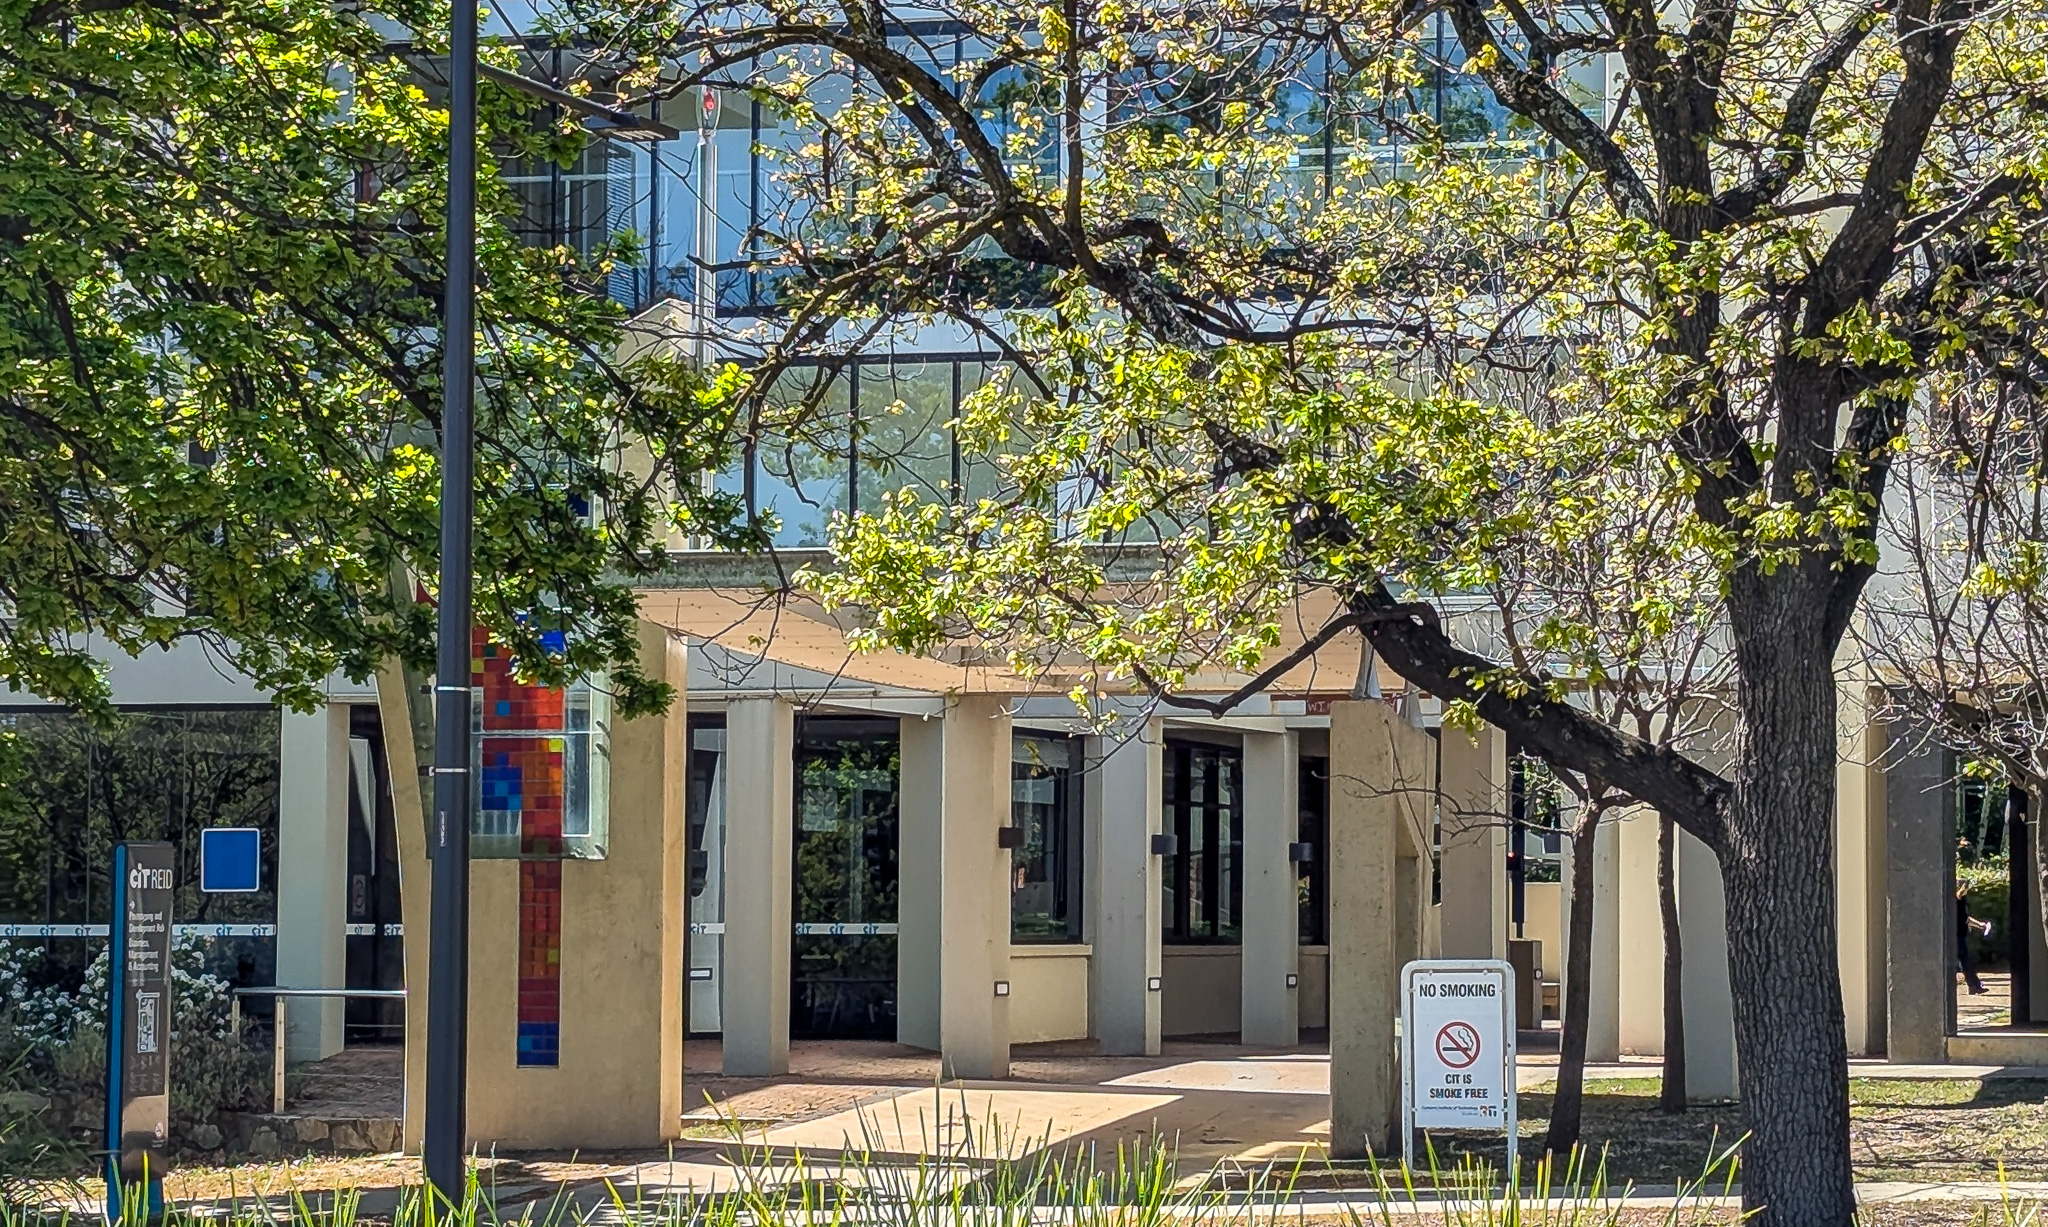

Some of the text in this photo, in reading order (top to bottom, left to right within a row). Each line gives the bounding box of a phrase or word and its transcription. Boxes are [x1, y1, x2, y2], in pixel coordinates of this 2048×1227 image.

[151, 868, 173, 889] REID
[1419, 984, 1496, 998] NO SMOKING
[1445, 1074, 1472, 1085] CIT IS
[1429, 1088, 1489, 1099] SMOKE FREE
